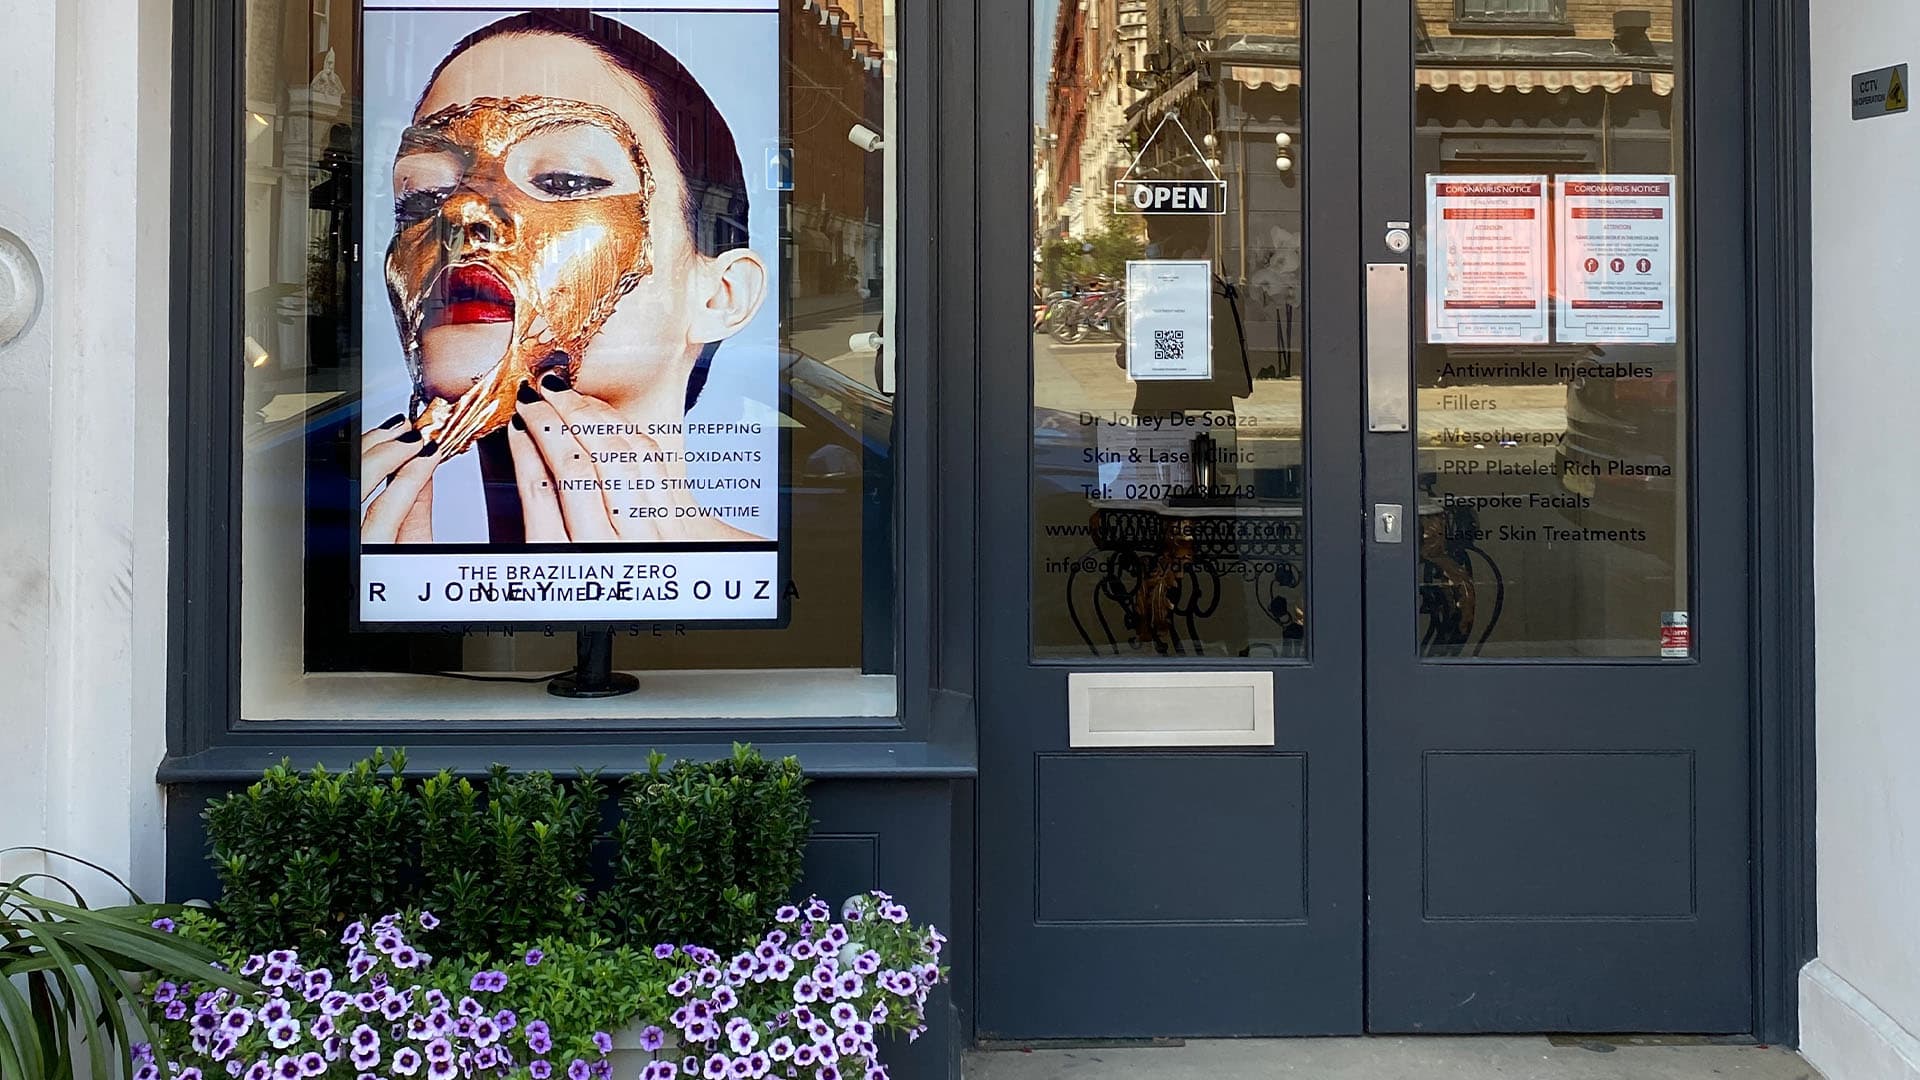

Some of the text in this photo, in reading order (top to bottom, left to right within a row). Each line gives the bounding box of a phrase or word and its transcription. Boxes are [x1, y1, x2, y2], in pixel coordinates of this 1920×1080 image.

[1860, 79, 1878, 93] CCTV
[1445, 185, 1531, 193] CORONAVIRUS NOTICE
[1574, 185, 1661, 193] CORONAVIRUS NOTICE
[1133, 186, 1208, 209] OPEN
[1441, 362, 1653, 383] Antiwrinkle Injectables
[1442, 395, 1497, 410] Fillers
[1079, 411, 1258, 431] Dr Joney De Souza
[560, 423, 762, 436] POWERFUL SKIN PREPPING
[1443, 427, 1566, 446] Mesotherapy
[590, 450, 762, 463] SUPER ANTI-OXIDANTS
[1083, 447, 1255, 463] Skin & Laser Clinic
[1443, 460, 1672, 476] PRP Platelet Rich Plasma
[558, 478, 761, 491] INTENSE LED STIMULATION
[1081, 484, 1113, 500] Tel:
[1443, 492, 1591, 510] Bespoke Facials
[629, 506, 760, 518] ZERO DOWNTIME
[1443, 525, 1646, 542] Laser Skin Treatments
[458, 564, 678, 581] THE BRAZILIAN ZERO
[418, 581, 554, 602] JONEY
[585, 581, 633, 601] DE
[664, 580, 801, 601] SOUZA
[469, 587, 587, 602] DOWNTIME
[440, 623, 687, 638] SKIN & LASER
